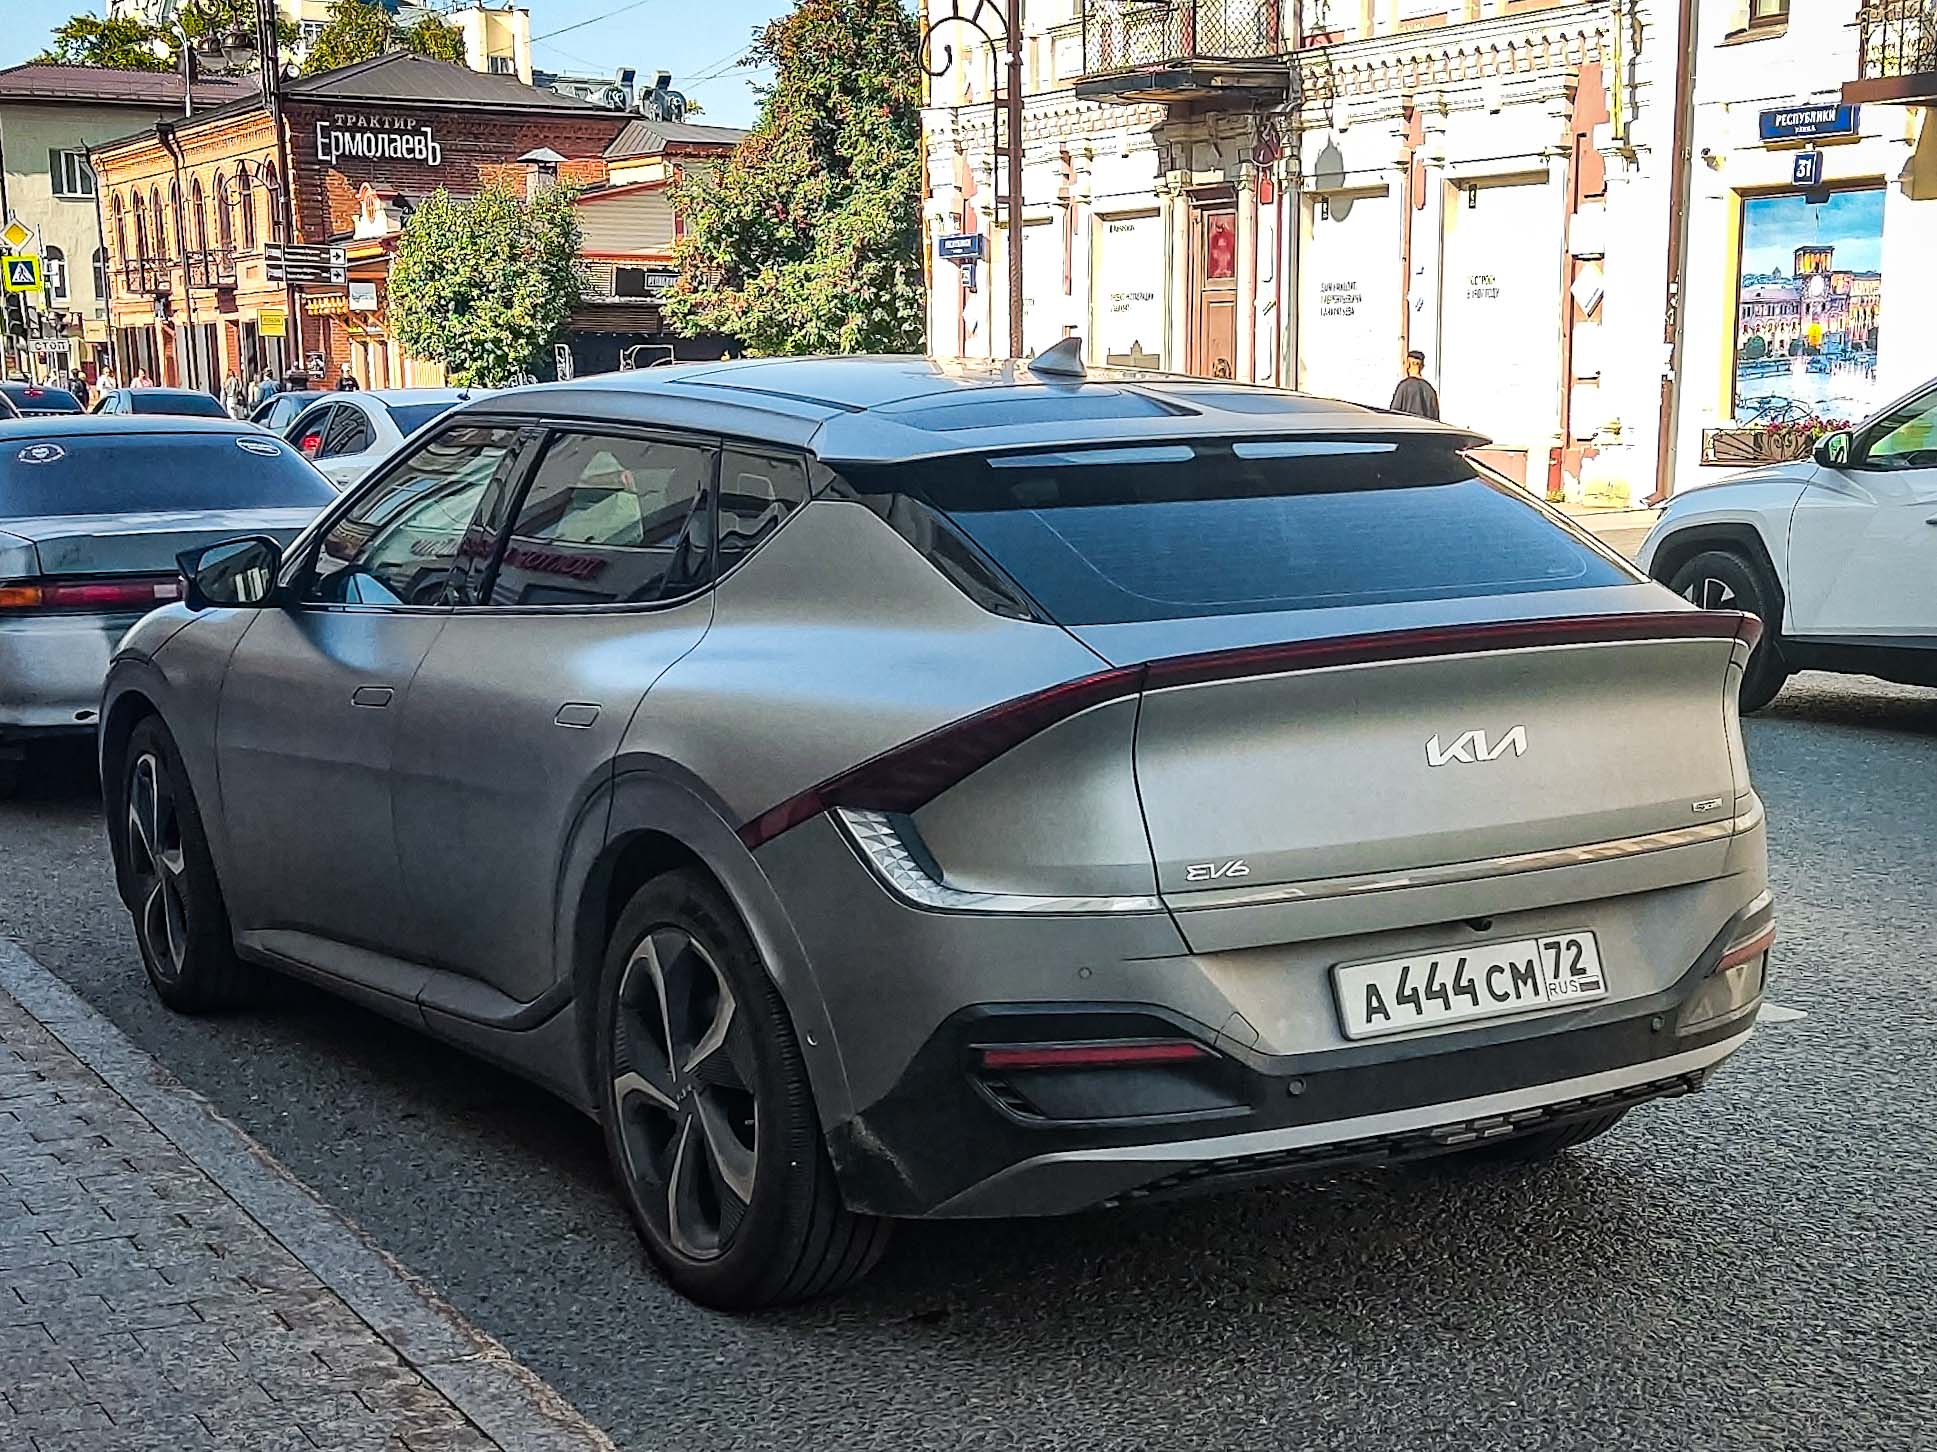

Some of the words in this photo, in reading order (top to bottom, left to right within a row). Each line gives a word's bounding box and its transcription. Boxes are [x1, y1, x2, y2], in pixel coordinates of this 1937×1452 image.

[334, 113, 417, 130] ТРАКТИР
[1774, 108, 1837, 128] РЕСПУБЛИКИ
[1795, 158, 1812, 178] 31
[34, 341, 66, 351] СТОП
[1425, 725, 1528, 767] KIA
[1185, 859, 1251, 881] EV6
[1543, 938, 1587, 980] 72
[1547, 981, 1579, 997] RUS
